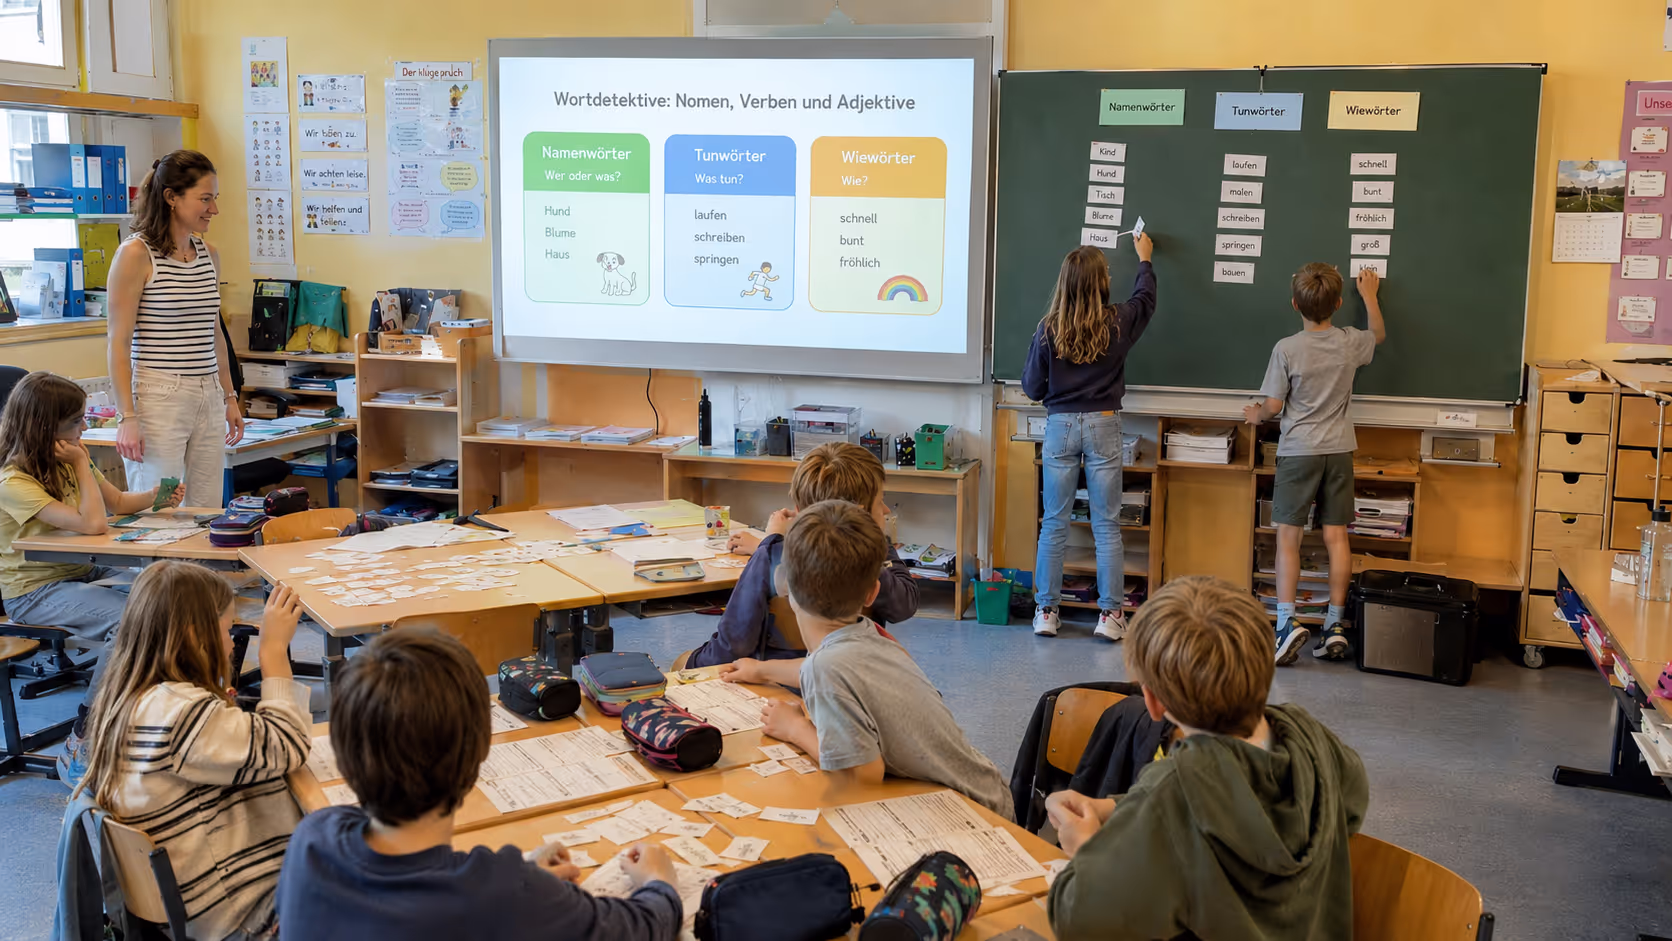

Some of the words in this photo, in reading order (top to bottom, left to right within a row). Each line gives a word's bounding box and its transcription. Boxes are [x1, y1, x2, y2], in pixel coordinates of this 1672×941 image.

[553, 91, 671, 108] Wortdetektive:
[675, 92, 734, 111] Nomen,
[739, 93, 797, 110] Verben
[802, 93, 832, 110] und
[836, 93, 916, 114] Adjektive
[1109, 102, 1176, 112] Namenwörter
[1232, 105, 1286, 117] Tunwörter
[1345, 105, 1402, 116] Wiewörter
[542, 145, 632, 160] Namenwörter
[693, 148, 767, 163] Tunwörter
[841, 150, 916, 165] Wiewörter
[1099, 147, 1117, 157] Kind
[1232, 160, 1258, 170] laufen
[1358, 159, 1388, 169] schnell
[544, 169, 566, 181] Wer
[568, 170, 593, 181] oder
[594, 171, 622, 182] was?
[694, 173, 718, 184] Was
[719, 173, 744, 185] tun?
[1096, 169, 1117, 178] Hund
[841, 175, 868, 186] Wie?
[1095, 189, 1116, 200] Tisch
[1229, 187, 1253, 197] malen
[1363, 186, 1382, 196] bunt
[544, 205, 571, 217] Hund
[694, 208, 727, 221] laufen
[1091, 210, 1114, 221] Blume
[839, 212, 878, 224] schnell
[1221, 213, 1260, 223] schreiben
[1355, 213, 1387, 222] fröhlich
[545, 226, 577, 238] Blume
[694, 231, 745, 243] schreiben
[1089, 233, 1109, 243] Haus
[839, 234, 865, 246] bunt
[1221, 240, 1256, 251] springen
[1360, 239, 1380, 252] groß
[545, 248, 570, 260] Haus
[694, 253, 740, 268] springen
[839, 255, 881, 268] fröhlich
[1222, 267, 1246, 277] bauen
